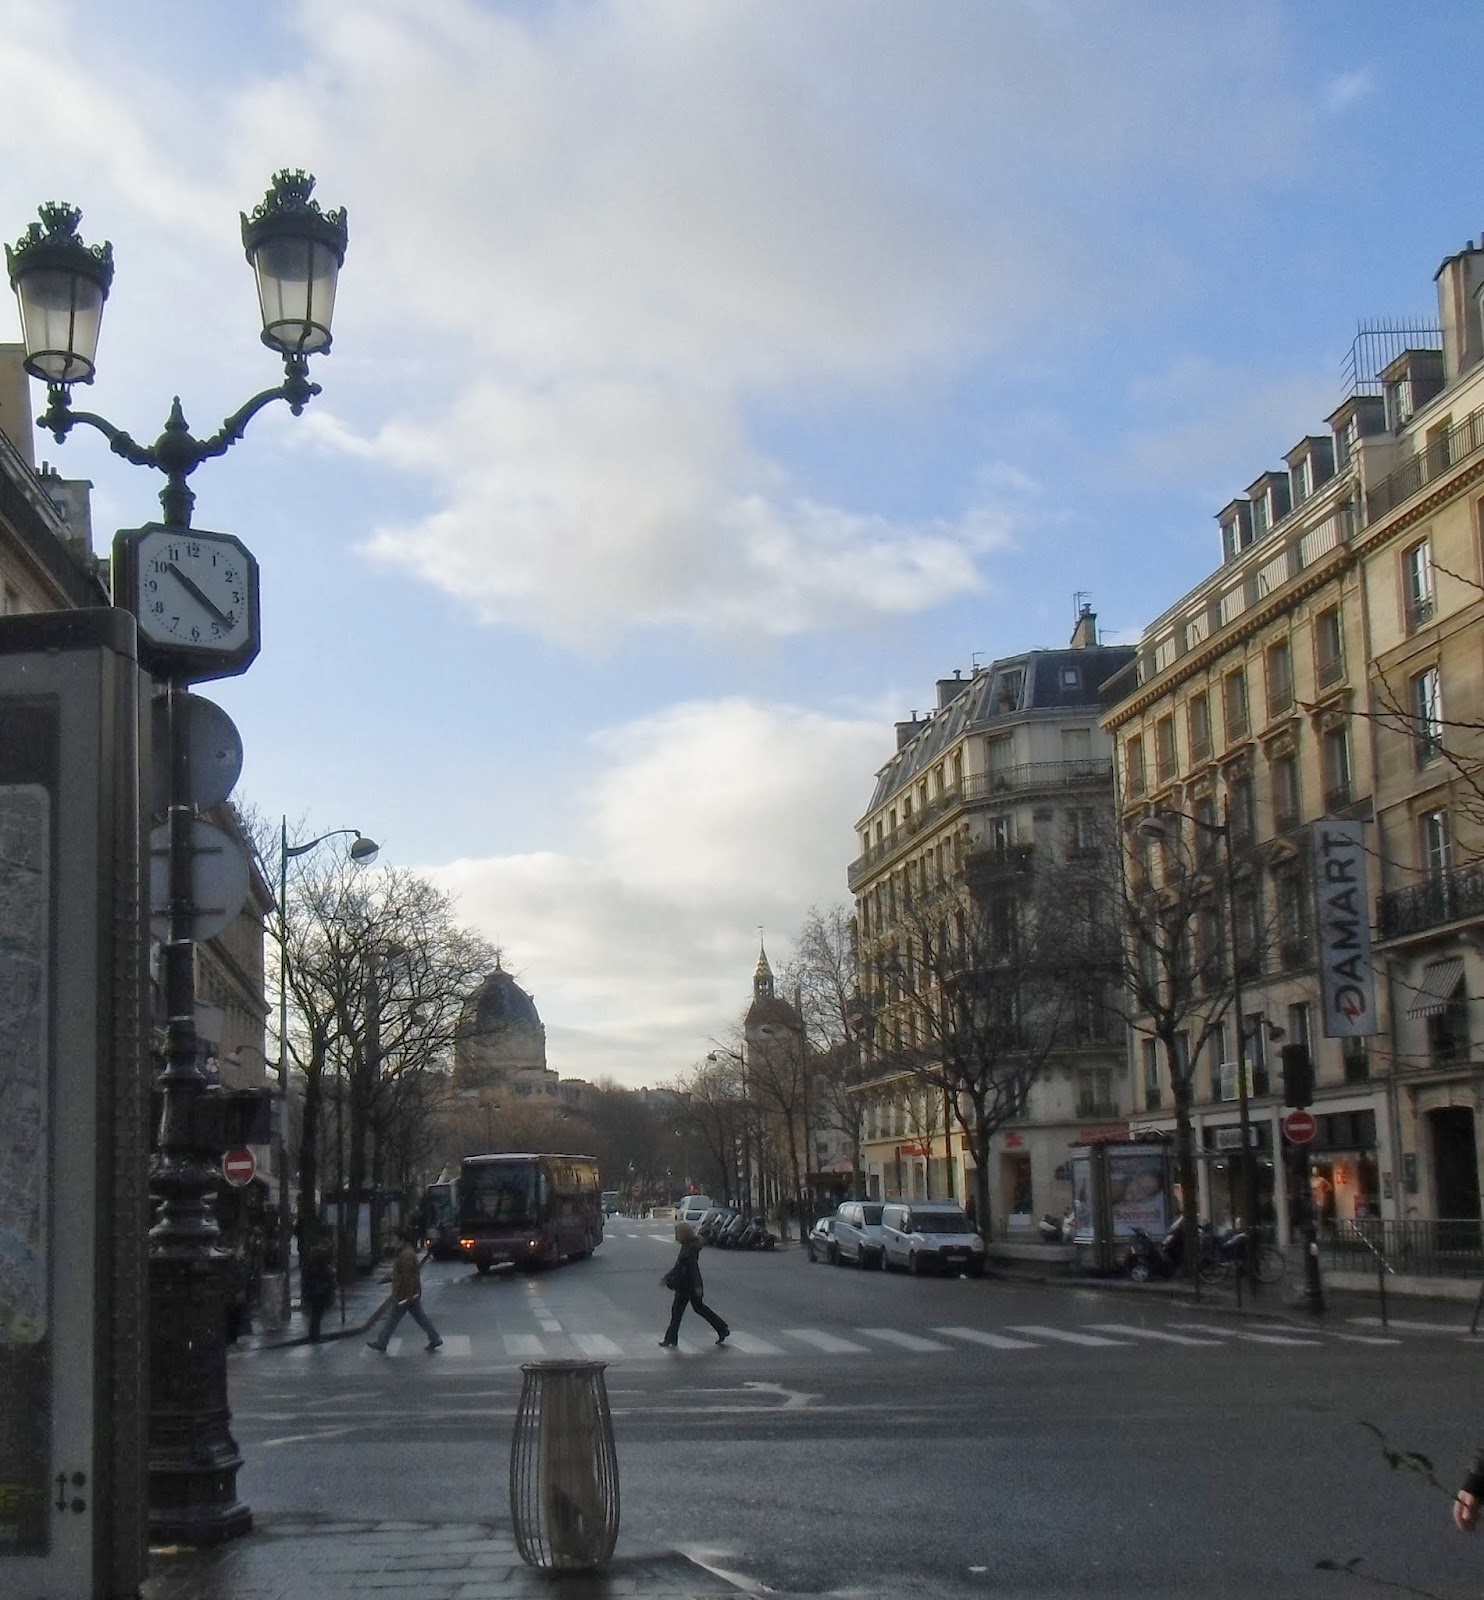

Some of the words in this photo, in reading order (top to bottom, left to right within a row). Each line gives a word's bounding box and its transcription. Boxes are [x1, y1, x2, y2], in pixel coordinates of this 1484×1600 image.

[169, 548, 179, 561] 11
[187, 542, 200, 558] 12
[155, 561, 167, 573] 10
[225, 571, 233, 583] 2
[149, 580, 158, 592] 9
[232, 591, 240, 604] 3
[155, 602, 164, 614] 8
[172, 616, 180, 630] 7
[211, 622, 219, 635] 5
[191, 626, 200, 638] 6
[1322, 831, 1366, 1013] DAMART
